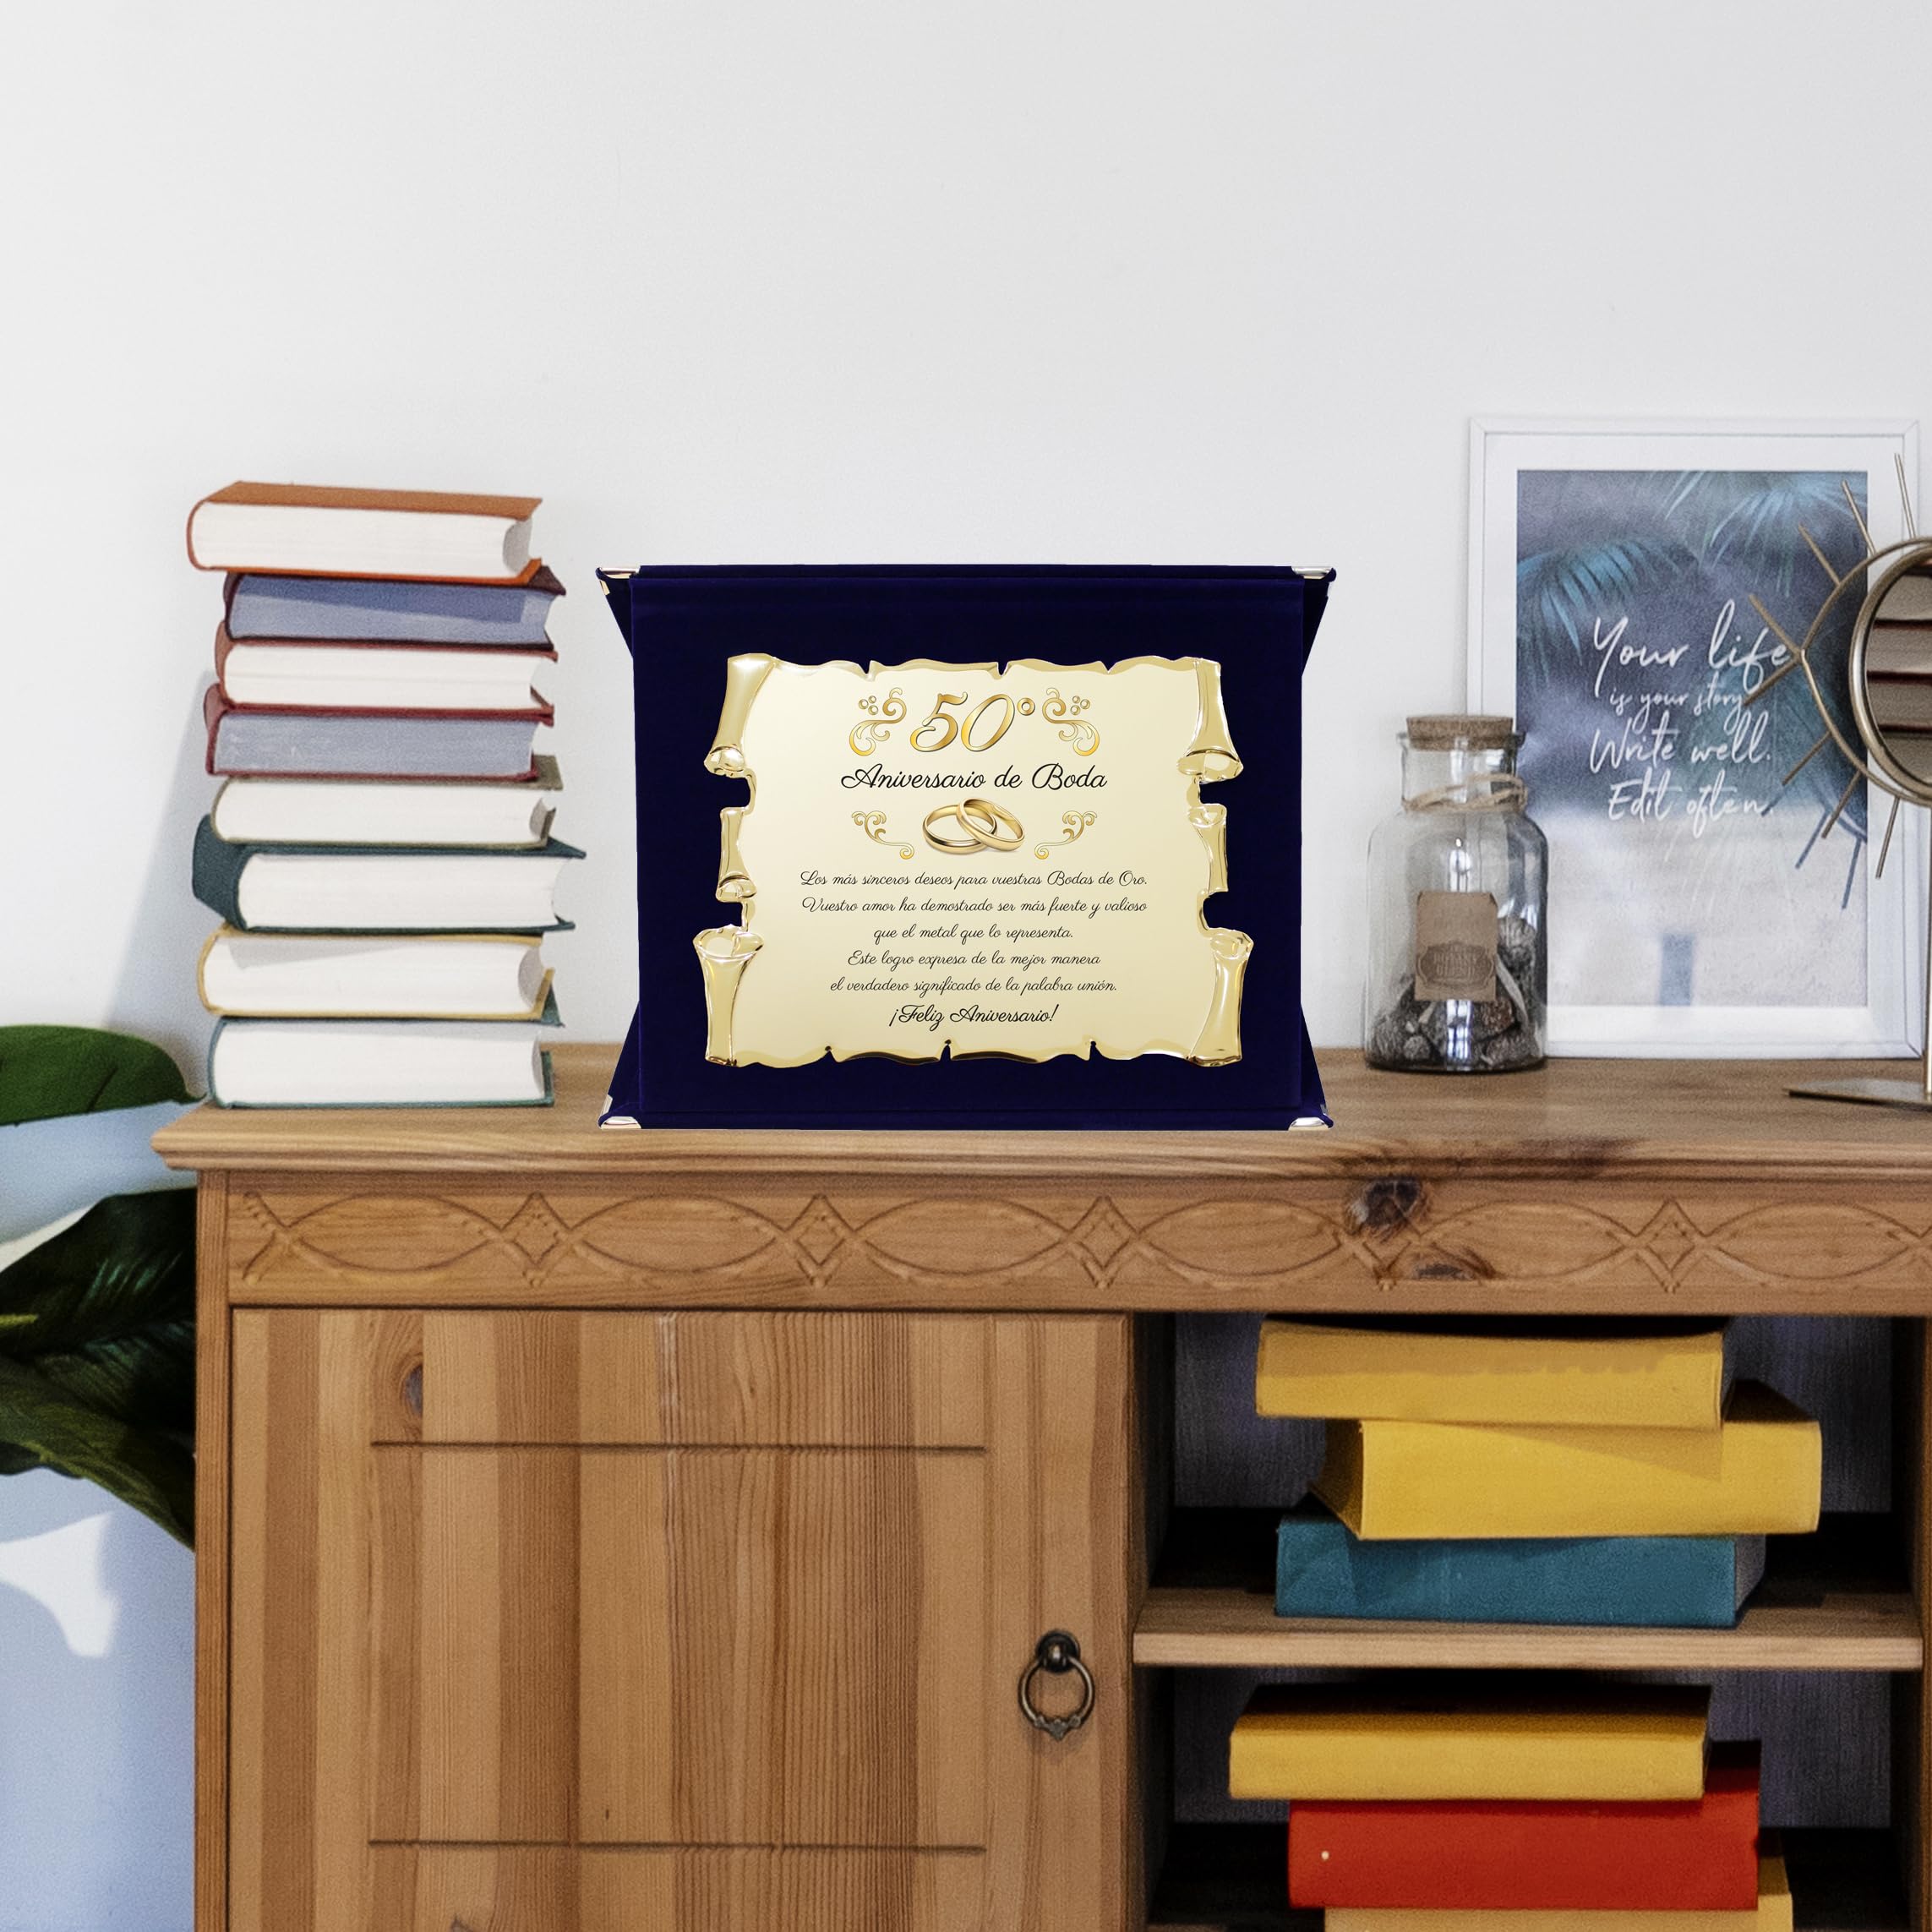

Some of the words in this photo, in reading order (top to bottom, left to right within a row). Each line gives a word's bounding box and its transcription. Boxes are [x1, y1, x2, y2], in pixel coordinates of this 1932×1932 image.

[1594, 616, 1689, 697] Your
[1708, 598, 1790, 694] life
[1609, 688, 1632, 717] is
[1632, 693, 1689, 734] your
[1590, 712, 1680, 773] Write
[1691, 711, 1771, 763] well.
[841, 763, 986, 789] Aniversario
[994, 765, 1023, 788] de
[1031, 762, 1108, 790] Boda
[1608, 767, 1682, 822] Edit
[800, 870, 828, 886] Los
[832, 873, 859, 886] más
[861, 874, 911, 886] sinceros
[914, 871, 954, 886] deseos
[953, 875, 989, 891] para
[991, 872, 1043, 886] vuestras
[1046, 870, 1094, 887] Bodas
[1098, 870, 1115, 886] de
[1118, 870, 1148, 887] Oro.
[801, 896, 859, 913] Vuestro
[861, 903, 897, 912] amor
[898, 896, 917, 912] ha
[920, 898, 994, 912] demostrado
[996, 902, 1017, 912] ser
[1020, 900, 1047, 912] más
[1047, 896, 1089, 917] fuerte
[1088, 902, 1101, 919] y
[1104, 896, 1148, 912] valioso
[873, 929, 898, 946] que
[901, 923, 918, 939] el
[919, 923, 959, 939] metal
[959, 929, 985, 946] que
[988, 923, 1002, 938] lo
[1005, 925, 1073, 944] representa.
[847, 949, 878, 966] Este
[881, 949, 915, 973] logro
[918, 955, 968, 970] expresa
[970, 950, 988, 965] de
[991, 949, 1007, 964] la
[1009, 954, 1047, 972] mejor
[1051, 955, 1101, 965] manera
[830, 975, 846, 991] el
[846, 977, 910, 991] verdadero
[913, 975, 982, 999] significado
[985, 977, 1002, 991] de
[1005, 975, 1021, 991] la
[1019, 975, 1074, 996] palabra
[1077, 980, 1117, 991] unión.
[888, 1003, 946, 1032] ¡Feliz
[949, 1003, 1060, 1023] Aniversario!
